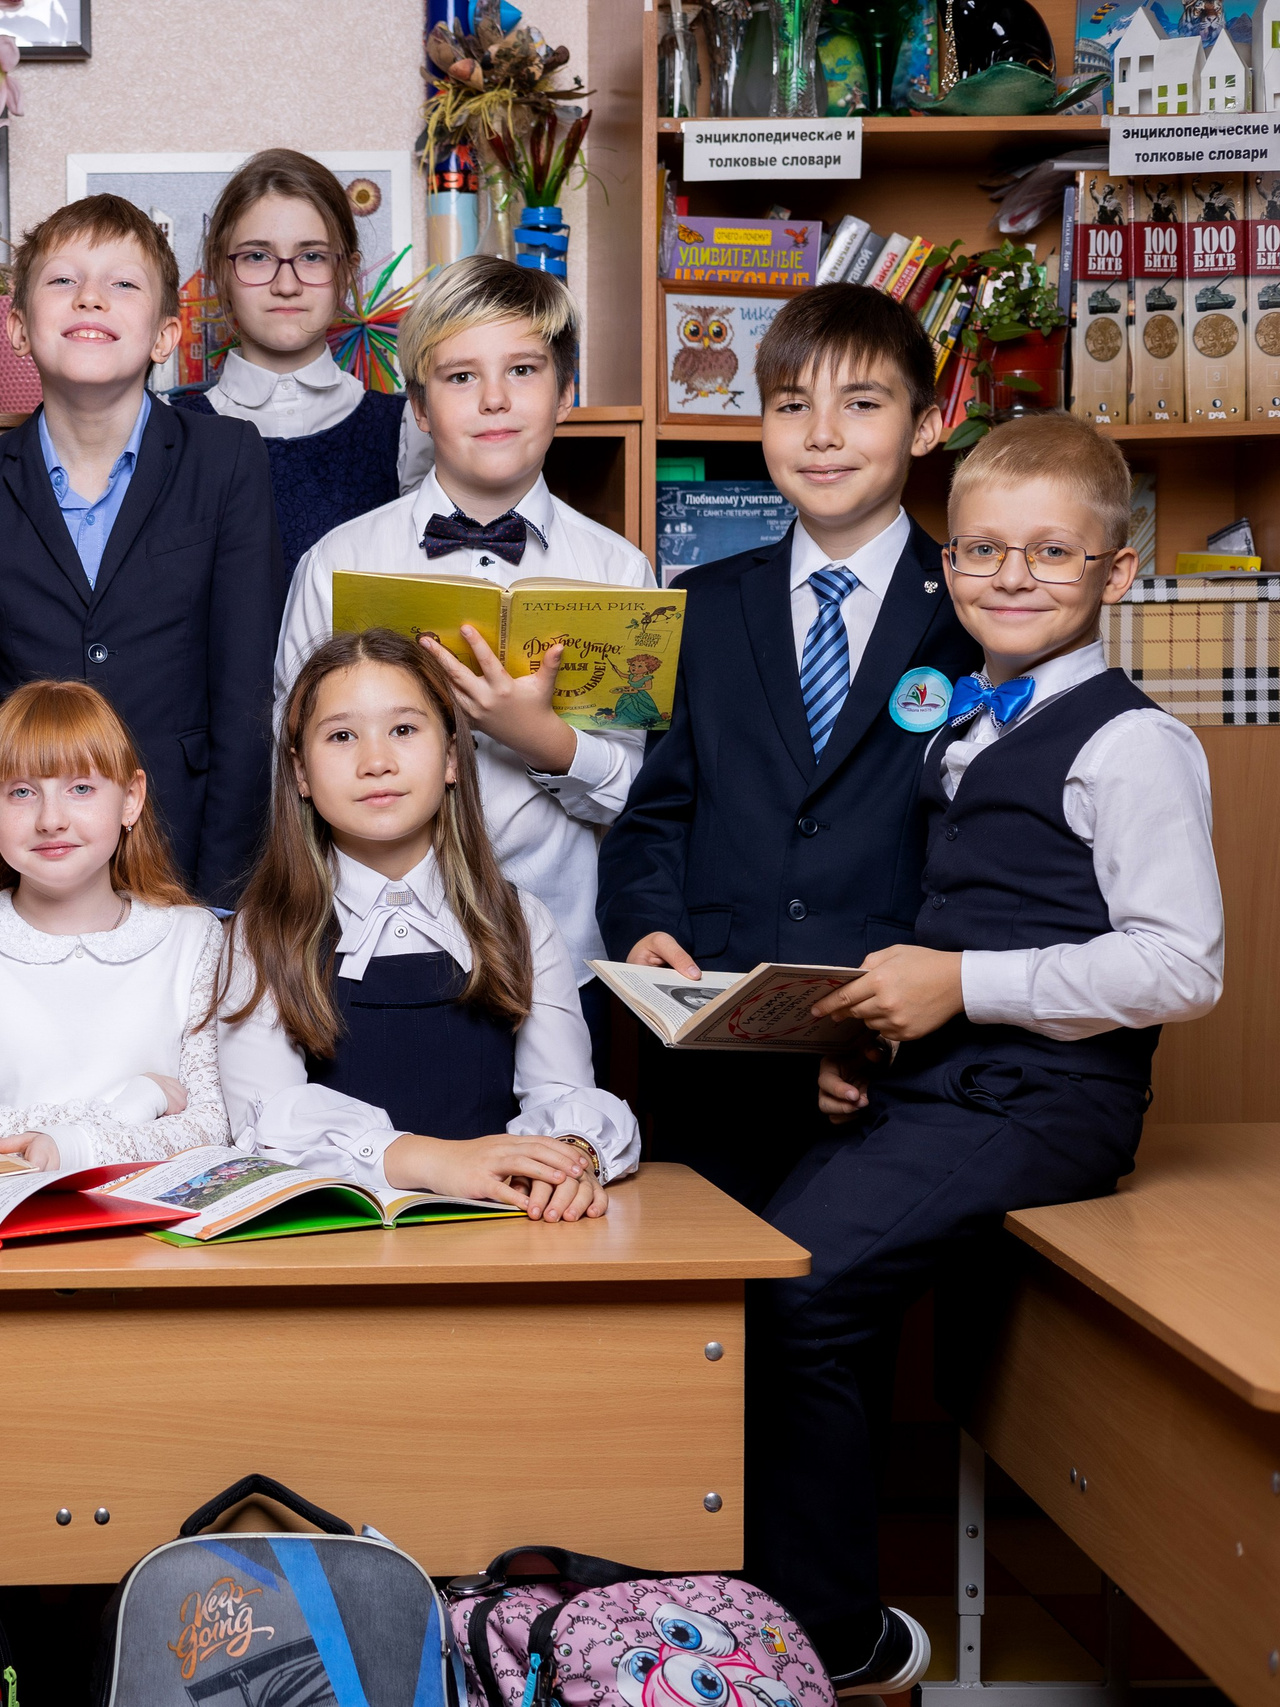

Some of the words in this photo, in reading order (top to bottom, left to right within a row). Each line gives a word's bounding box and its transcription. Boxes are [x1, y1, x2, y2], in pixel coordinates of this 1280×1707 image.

[695, 130, 842, 145] энциклопедические
[847, 130, 855, 140] и
[1122, 124, 1269, 141] энциклопедические
[709, 155, 777, 168] толковые
[781, 154, 841, 168] словари
[1135, 150, 1204, 163] толковые
[1208, 148, 1268, 162] словари
[1088, 229, 1123, 257] 100
[1144, 227, 1177, 254] 100
[1193, 226, 1236, 254] 100
[1256, 225, 1280, 252] 10
[678, 246, 804, 269] УДИВИТЕЛЬНЫЕ
[1088, 257, 1122, 271] БИТВ
[1144, 254, 1177, 268] БИТВ
[1193, 253, 1236, 268] БИТВ
[685, 494, 739, 508] Любимому
[740, 495, 783, 508] учителю
[763, 509, 778, 517] 2020
[664, 523, 672, 533] 4
[523, 602, 604, 611] ТАТЬЯНА
[608, 602, 646, 611] РИК
[741, 991, 788, 1025] ИСТОРИЯ
[181, 1577, 263, 1628] Keep
